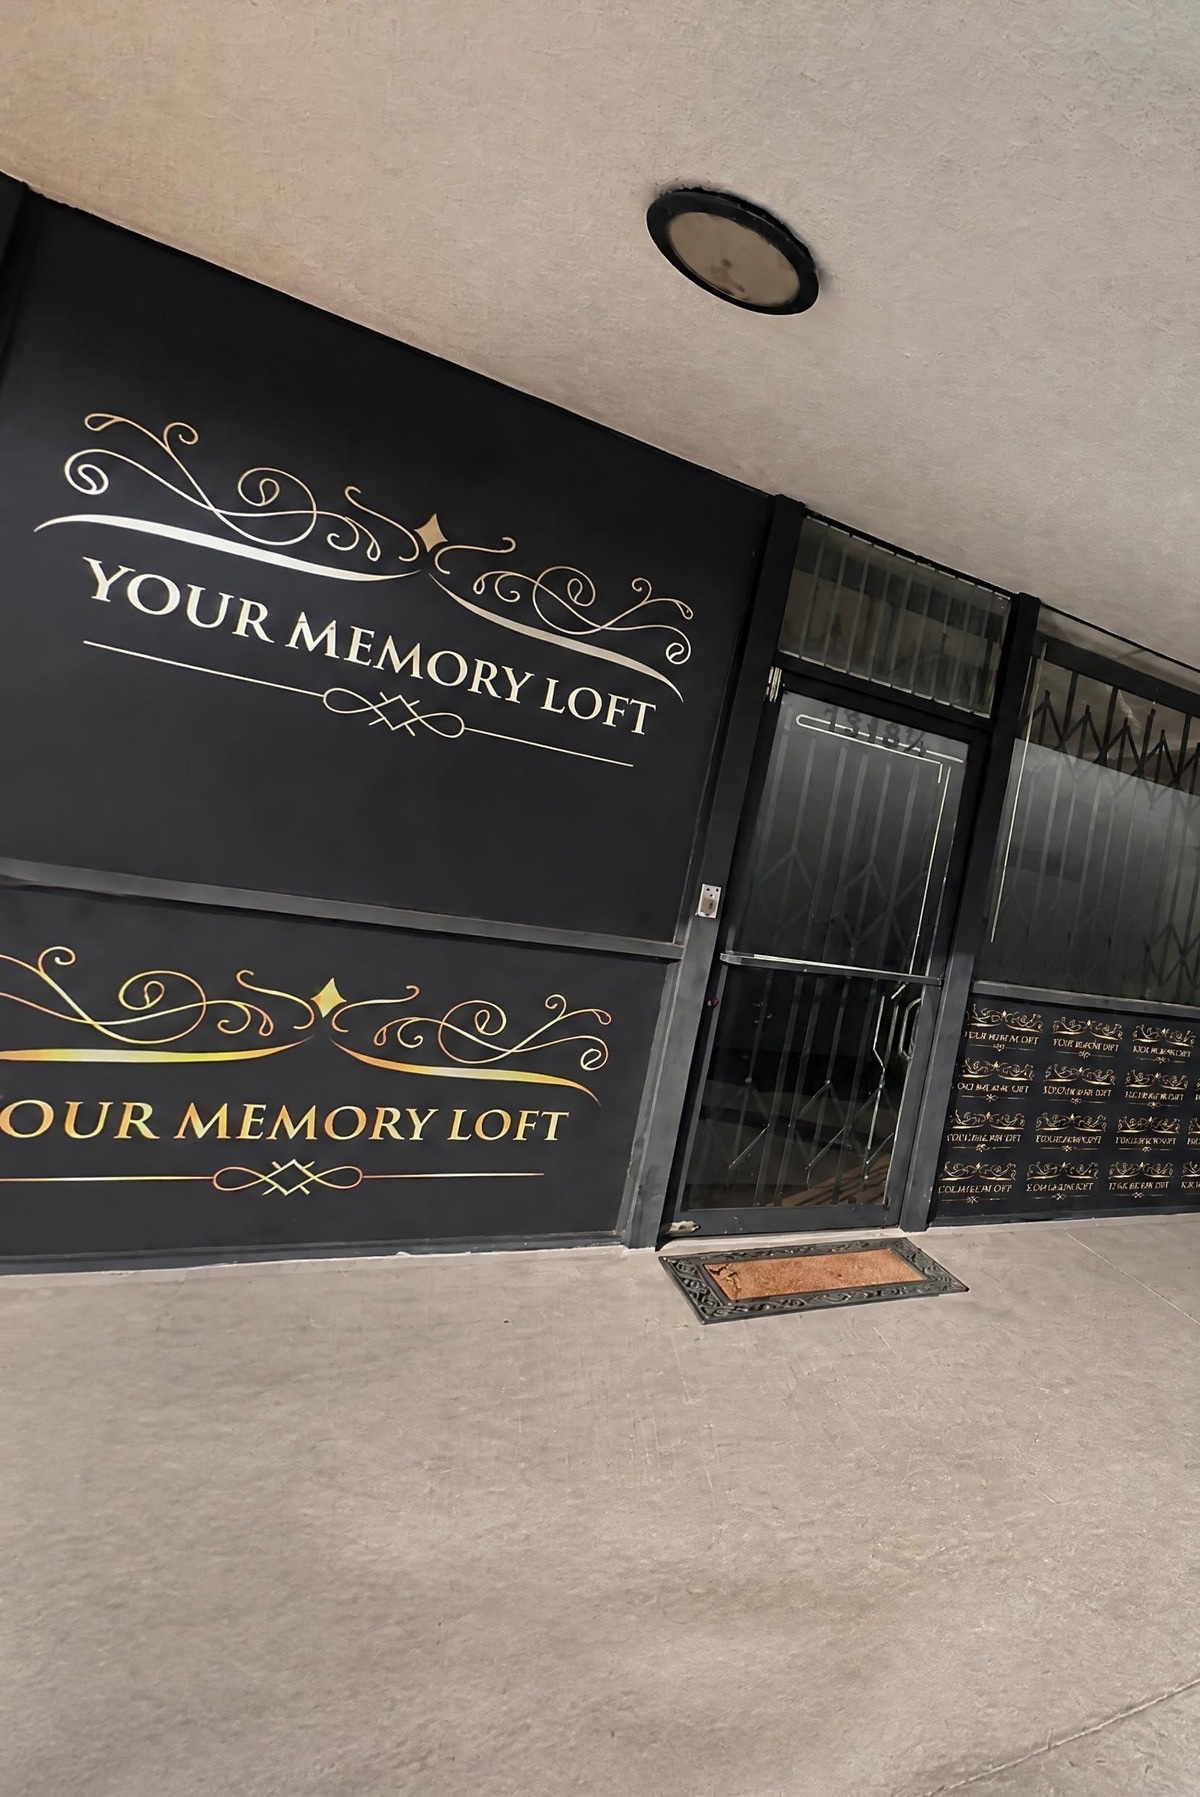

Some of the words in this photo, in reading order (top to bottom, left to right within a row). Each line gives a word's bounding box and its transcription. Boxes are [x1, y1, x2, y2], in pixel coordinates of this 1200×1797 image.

[82, 556, 275, 644] YOUR
[285, 611, 535, 704] MEMORY
[540, 677, 657, 735] LOFT
[0, 1100, 161, 1140] OUR
[173, 1102, 439, 1141] MEMORY
[446, 1108, 570, 1141] LOFT
